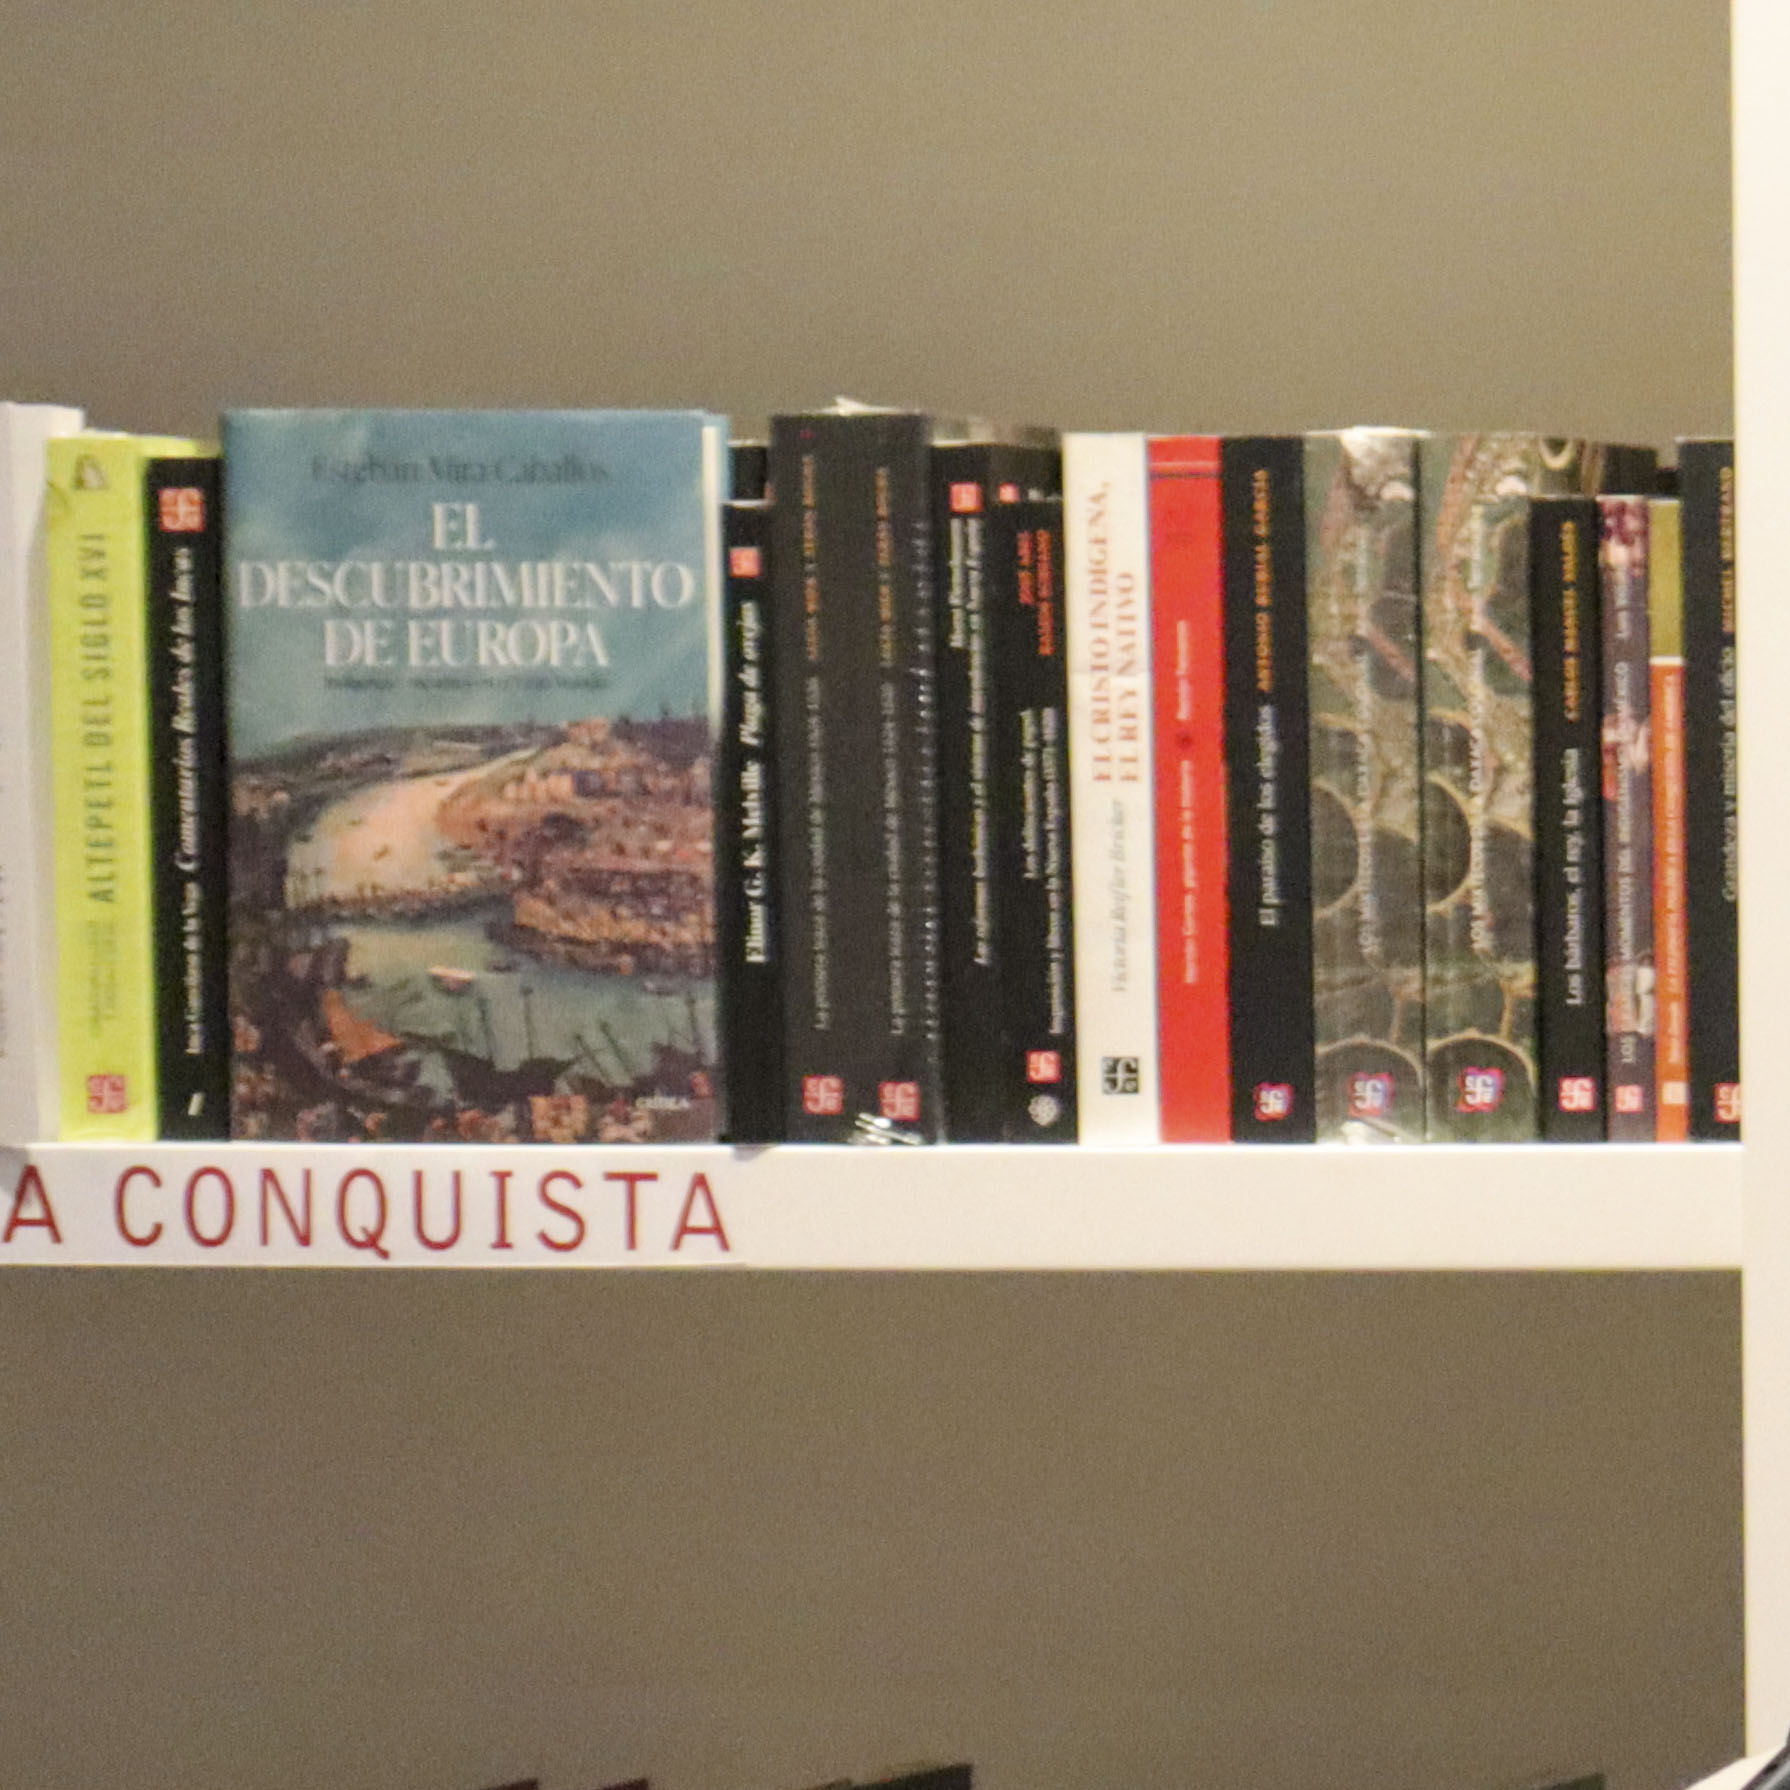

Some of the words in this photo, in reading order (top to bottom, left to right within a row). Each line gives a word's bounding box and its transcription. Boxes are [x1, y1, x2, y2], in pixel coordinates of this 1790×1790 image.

[431, 503, 495, 551] EL
[237, 560, 694, 610] DESCUBRIMIENTO
[80, 594, 111, 681] SIGLO
[323, 619, 395, 668] DE
[407, 619, 612, 668] EUROPA
[83, 697, 112, 748] DEL
[85, 760, 116, 904] ALTEPETL
[113, 1163, 731, 1260] CONQUISTA
